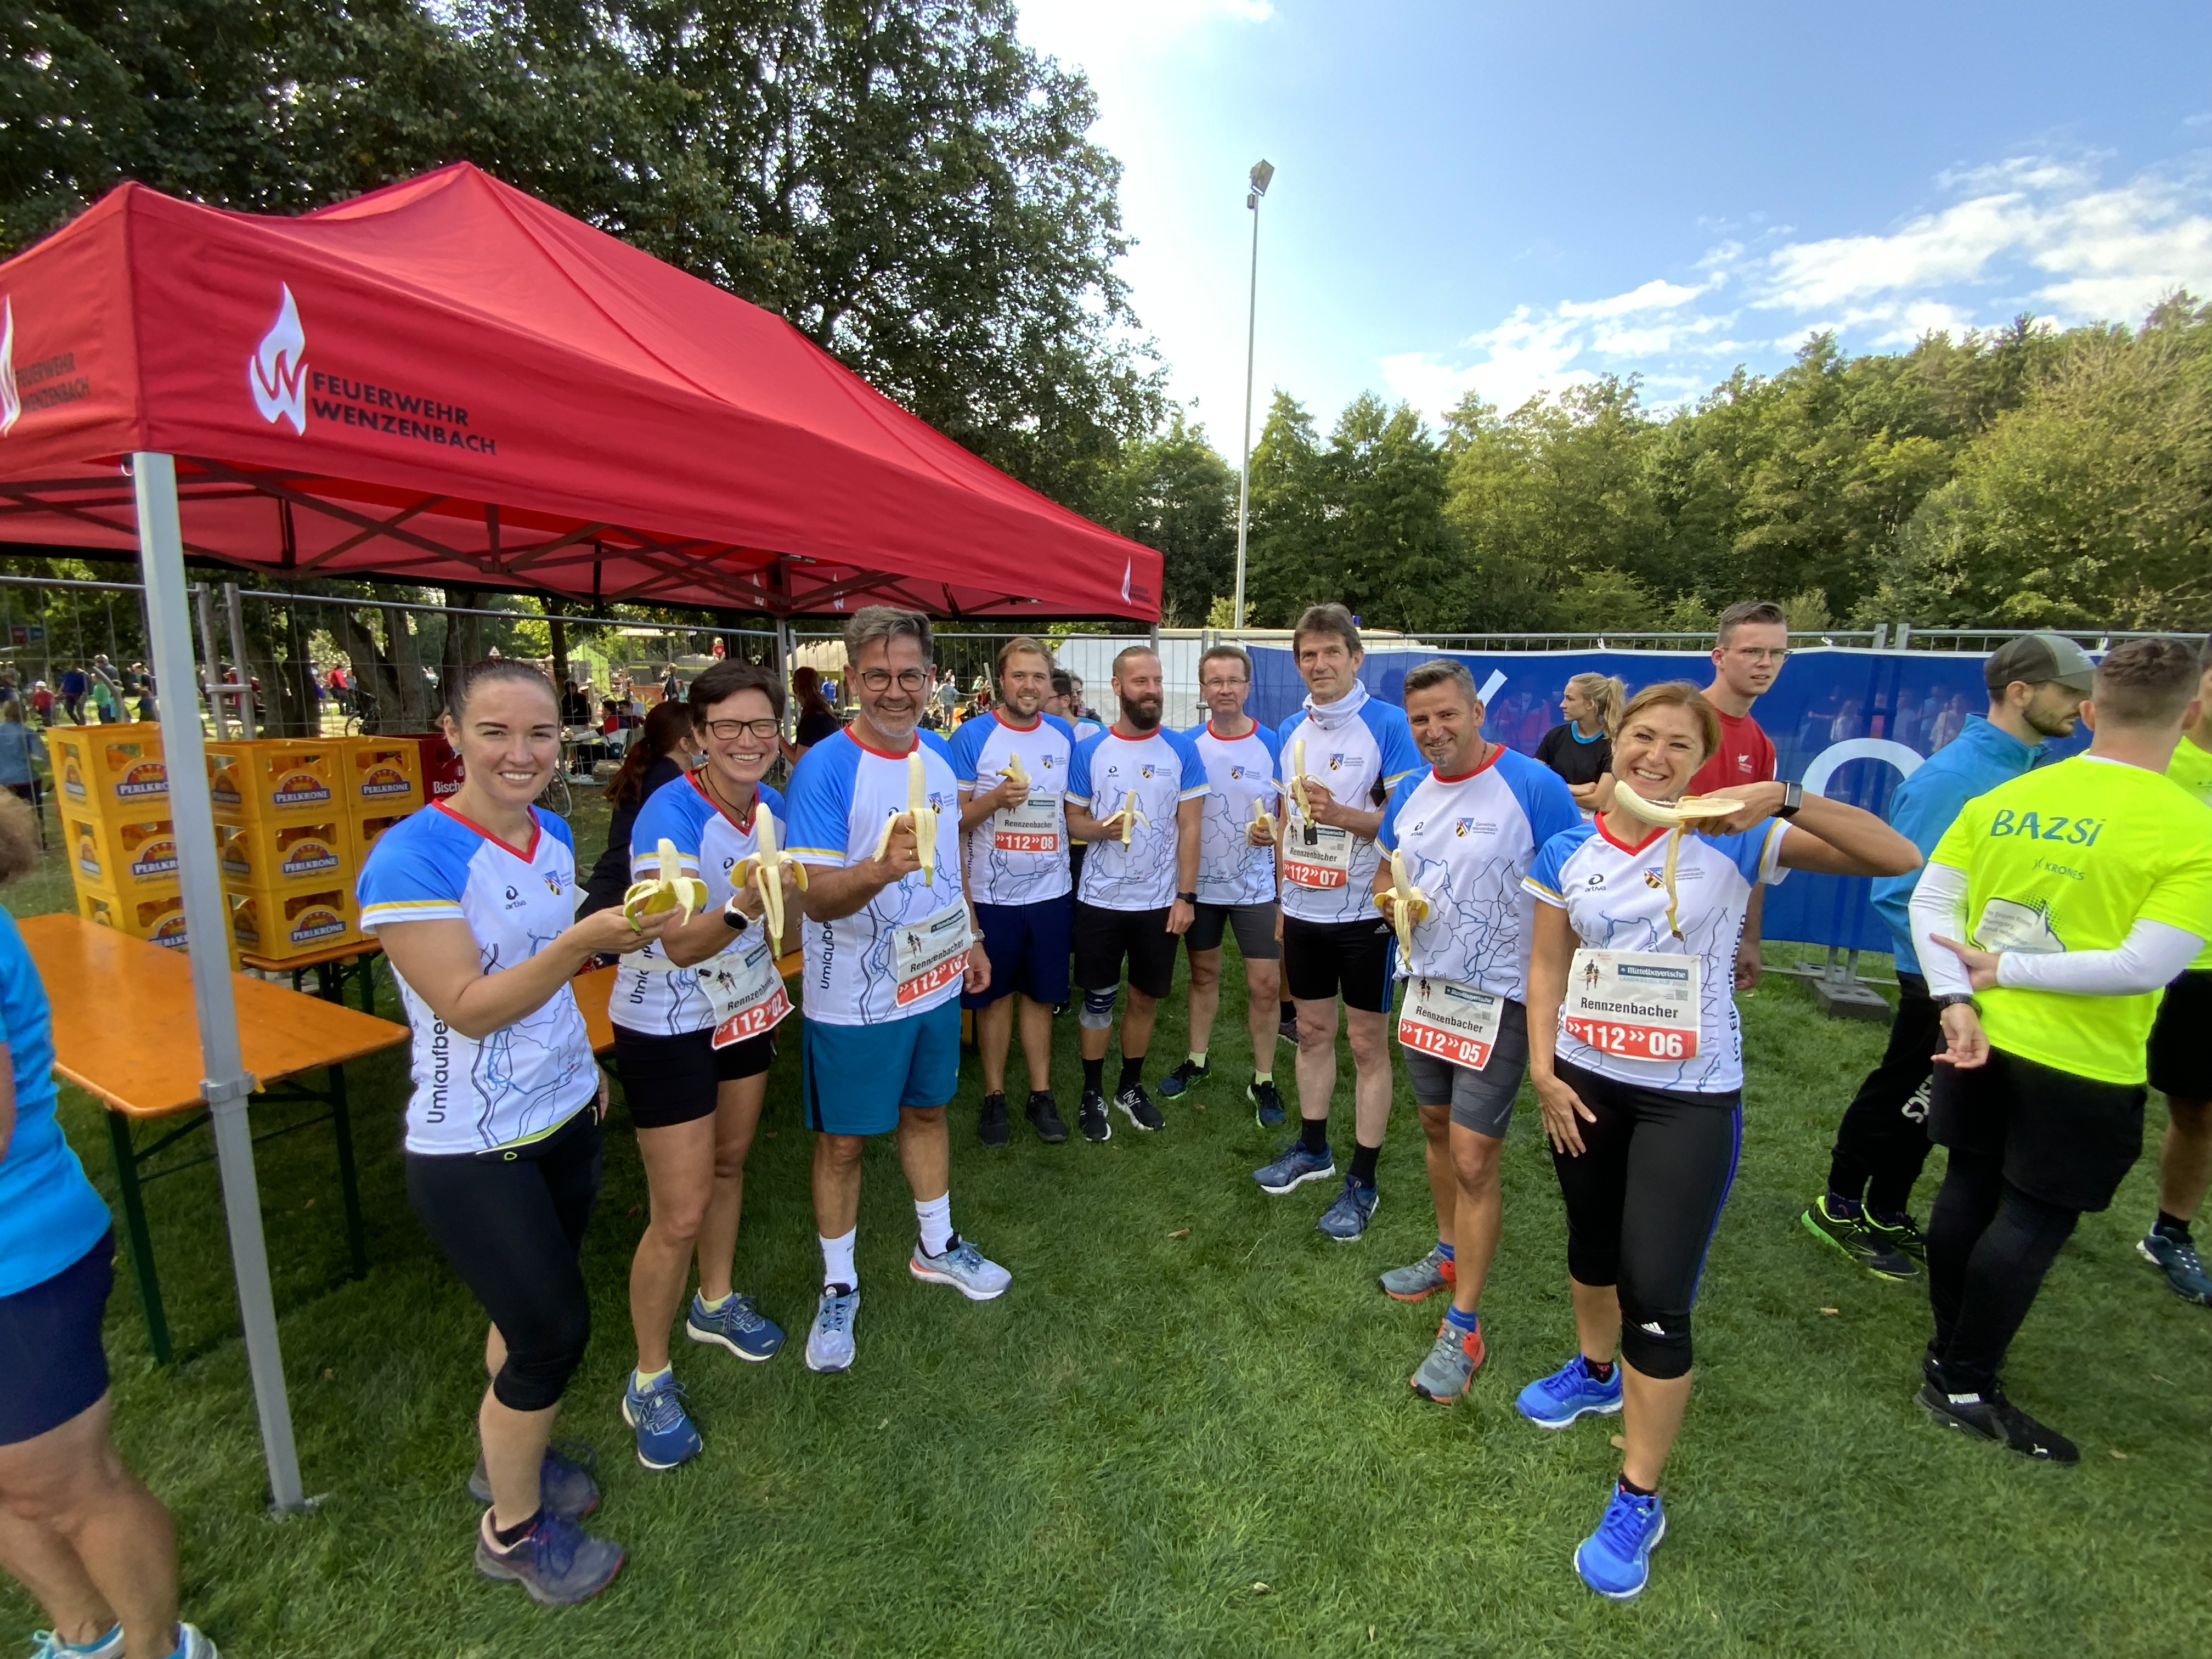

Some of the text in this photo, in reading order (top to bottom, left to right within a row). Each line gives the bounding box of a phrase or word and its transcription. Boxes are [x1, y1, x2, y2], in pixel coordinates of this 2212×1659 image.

[312, 371, 469, 426] FEUERWEHR
[312, 397, 496, 455] WENZENBACH
[120, 782, 170, 794] PERLKRO
[276, 790, 329, 803] PERLKRONE
[363, 783, 409, 794] PERLKRONE
[1005, 819, 1052, 828] Rennzenbacher
[1006, 835, 1054, 850] 112 08
[285, 856, 338, 872] PERLKRONE
[1289, 847, 1338, 862] Rennzenbacher
[1290, 864, 1310, 883] 112
[1319, 870, 1339, 886] 07
[2044, 861, 2085, 881] KRONES
[505, 899, 527, 910] artiva
[294, 923, 345, 941] PERLKRONE
[1627, 966, 1686, 979] Mittelbayerische
[911, 970, 941, 996] 112
[1581, 997, 1679, 1019] Rennzenbacher
[730, 1007, 767, 1036] 112
[1415, 1005, 1483, 1034] Rennzenbacher
[1414, 1026, 1482, 1063] 112 05
[1583, 1024, 1683, 1058] 112 06
